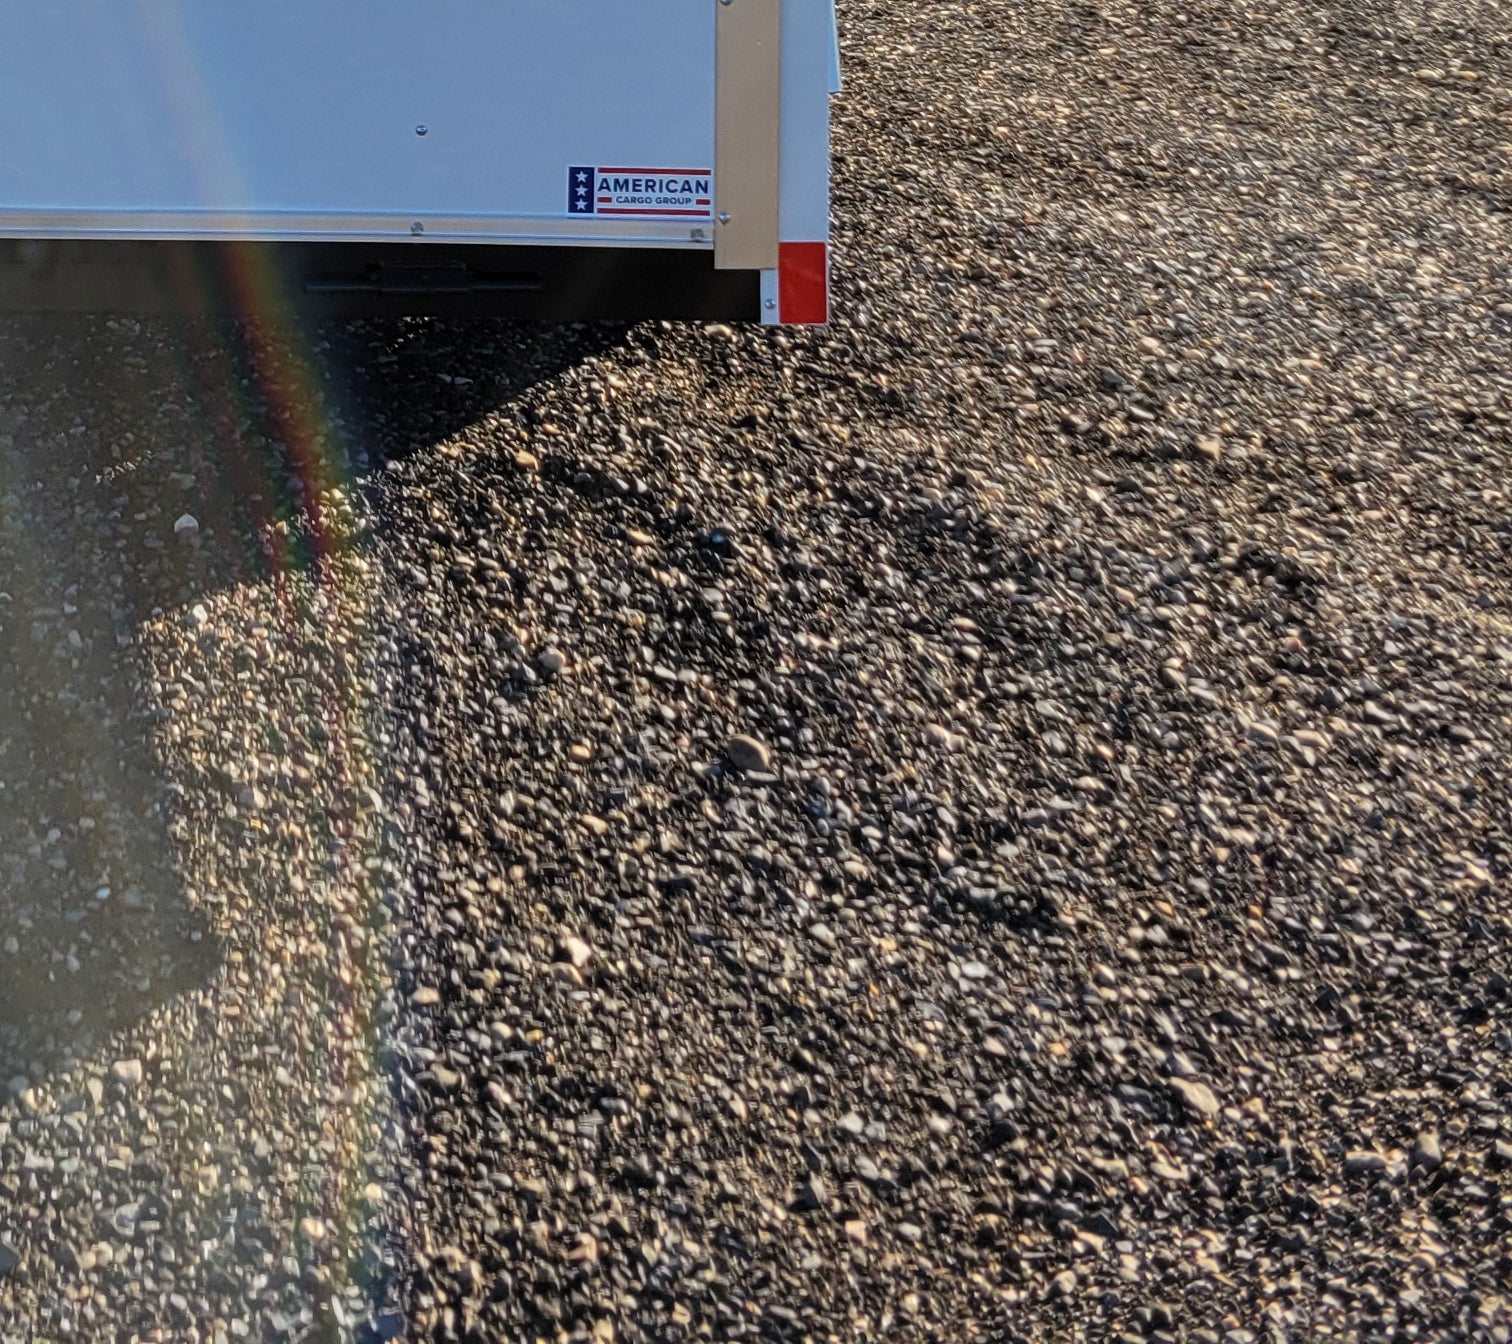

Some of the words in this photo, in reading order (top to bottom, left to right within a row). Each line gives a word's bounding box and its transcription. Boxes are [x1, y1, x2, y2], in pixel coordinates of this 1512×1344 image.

[597, 177, 709, 195] AMERICAN
[615, 195, 653, 205] CARGO
[655, 196, 692, 205] GROUP
